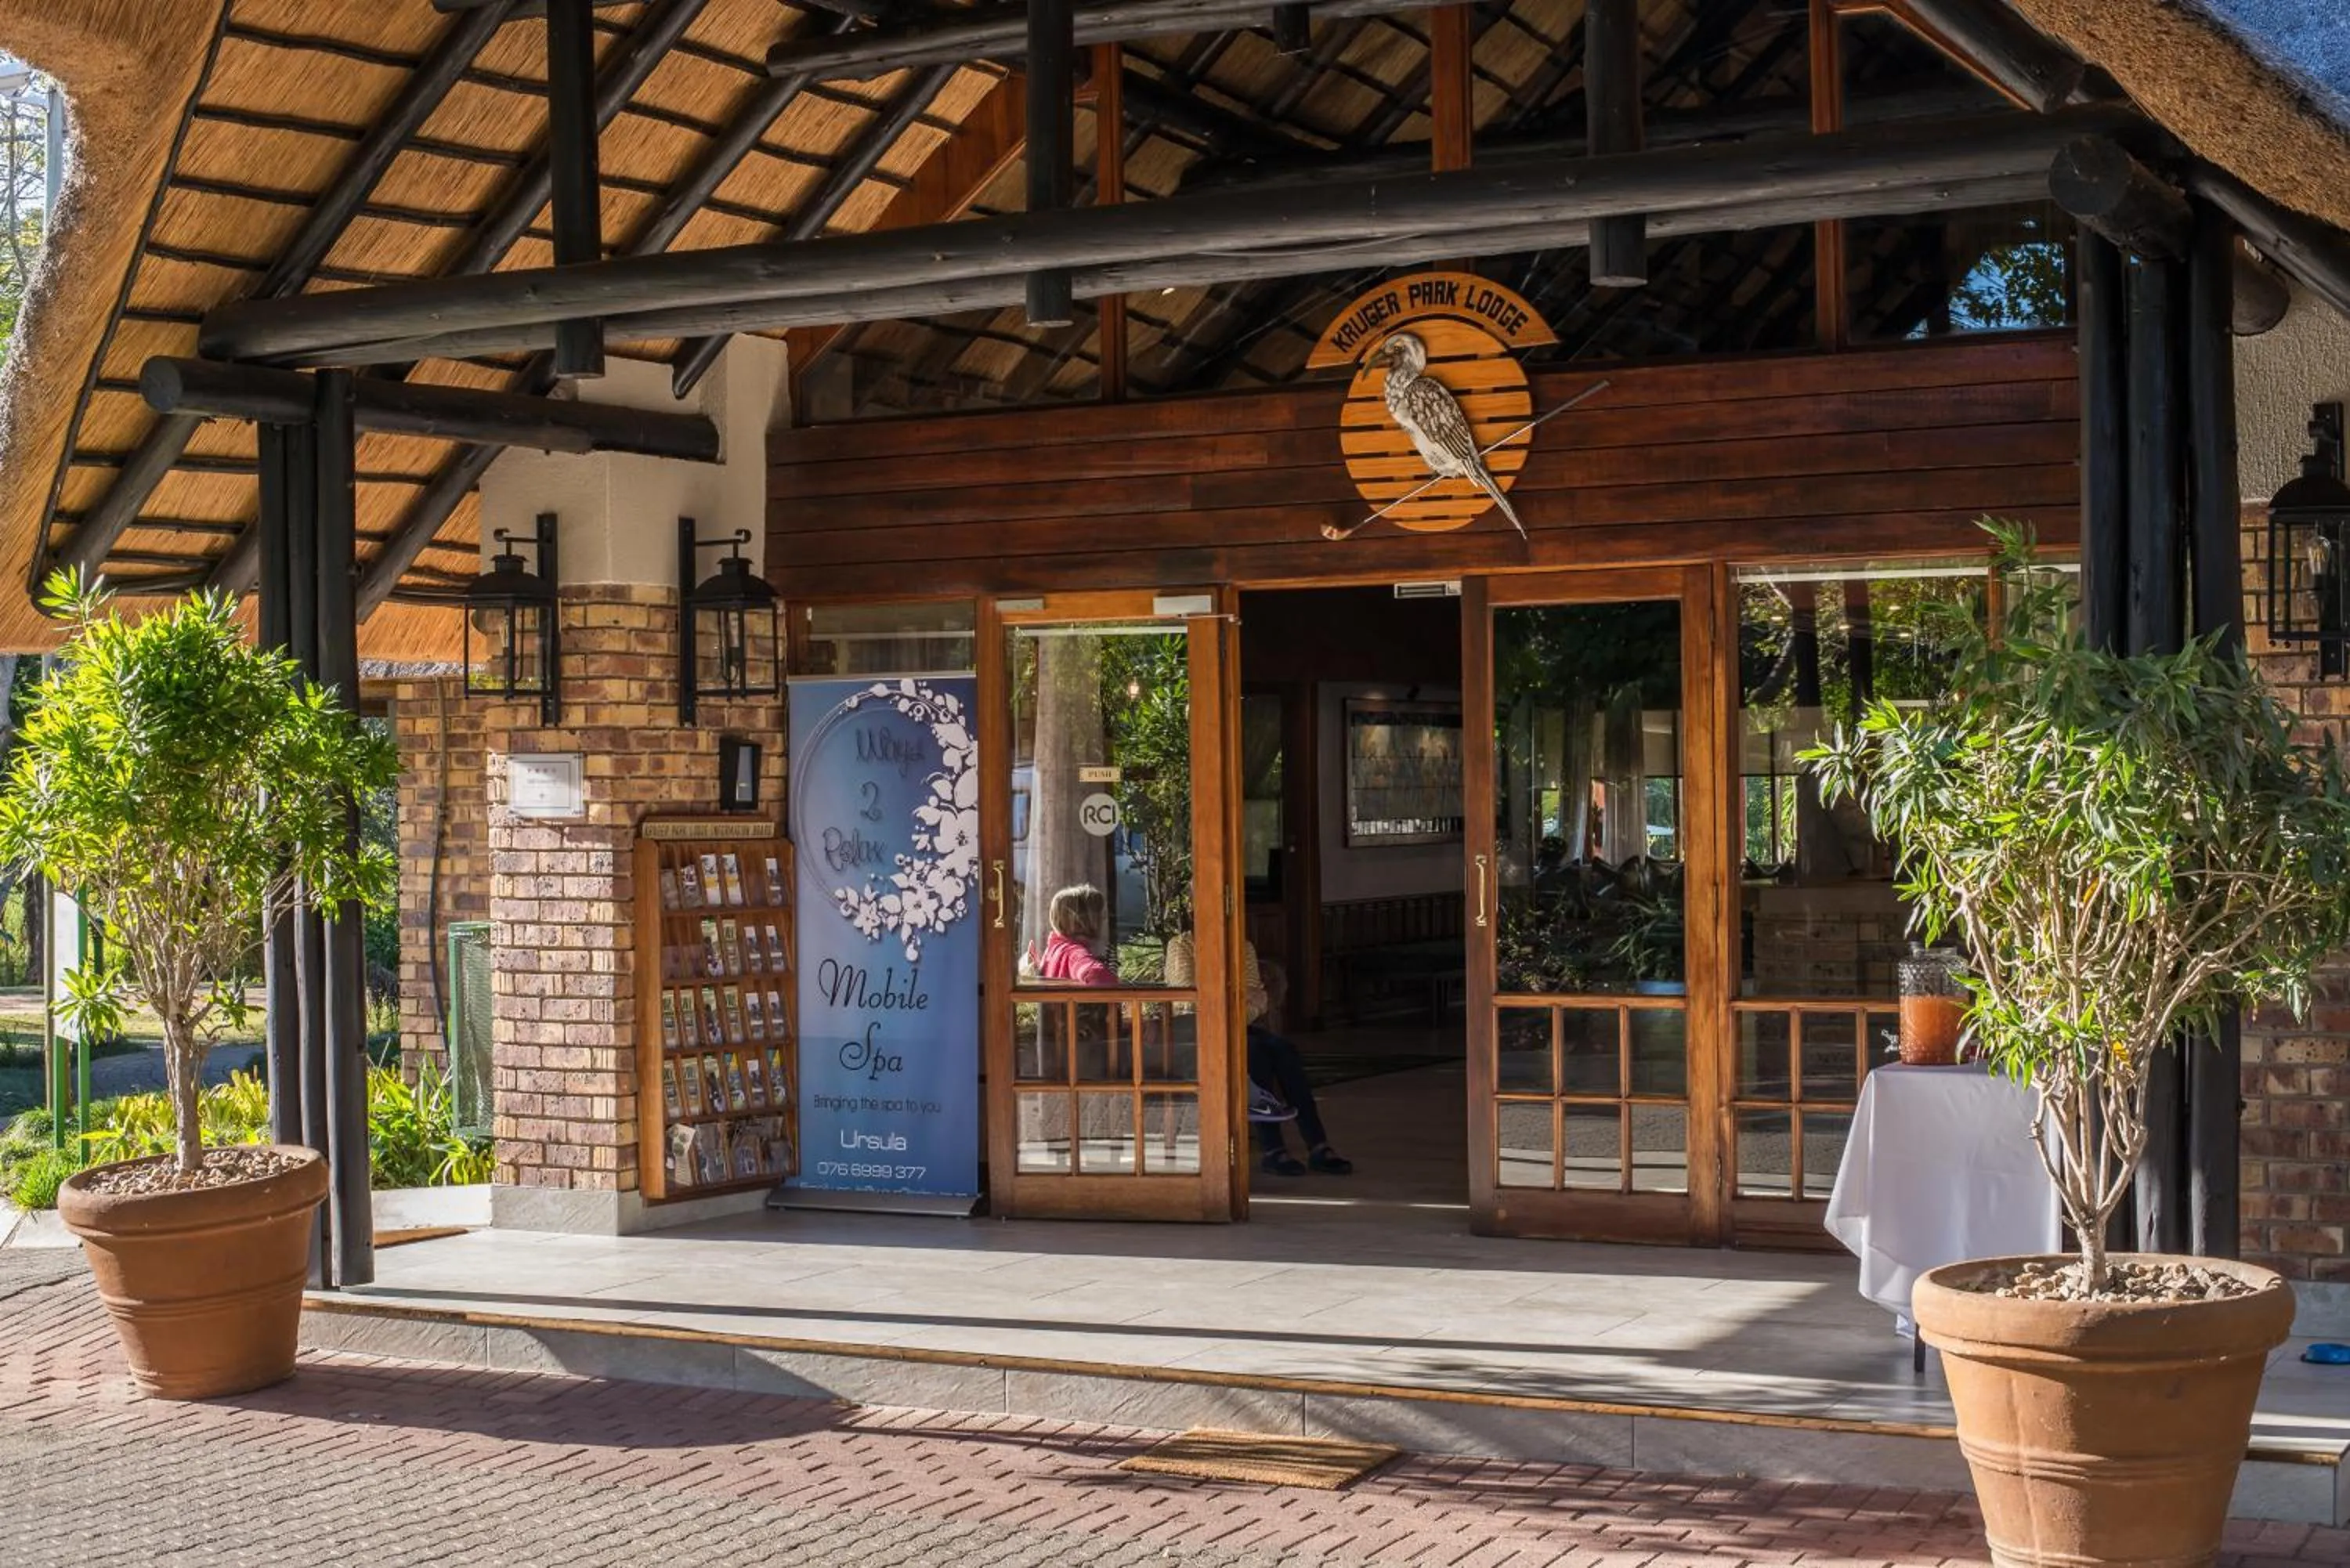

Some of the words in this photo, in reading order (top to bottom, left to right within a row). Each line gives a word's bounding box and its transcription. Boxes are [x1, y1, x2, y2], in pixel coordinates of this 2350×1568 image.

[1331, 291, 1401, 353] KRUGER
[1408, 280, 1460, 309] PARK
[1464, 284, 1530, 337] LODGE
[859, 780, 884, 821] 2
[1083, 804, 1116, 825] RCI
[822, 826, 886, 872] Relax
[818, 958, 929, 1010] Mobile
[840, 1021, 903, 1081] Spa
[814, 1094, 858, 1113] Bringing
[860, 1095, 878, 1110] the
[881, 1099, 904, 1114] spa
[905, 1097, 919, 1112] to
[920, 1101, 942, 1115] you
[840, 1129, 908, 1151] Ursula
[816, 1162, 848, 1176] 076
[895, 1165, 927, 1180] 377
